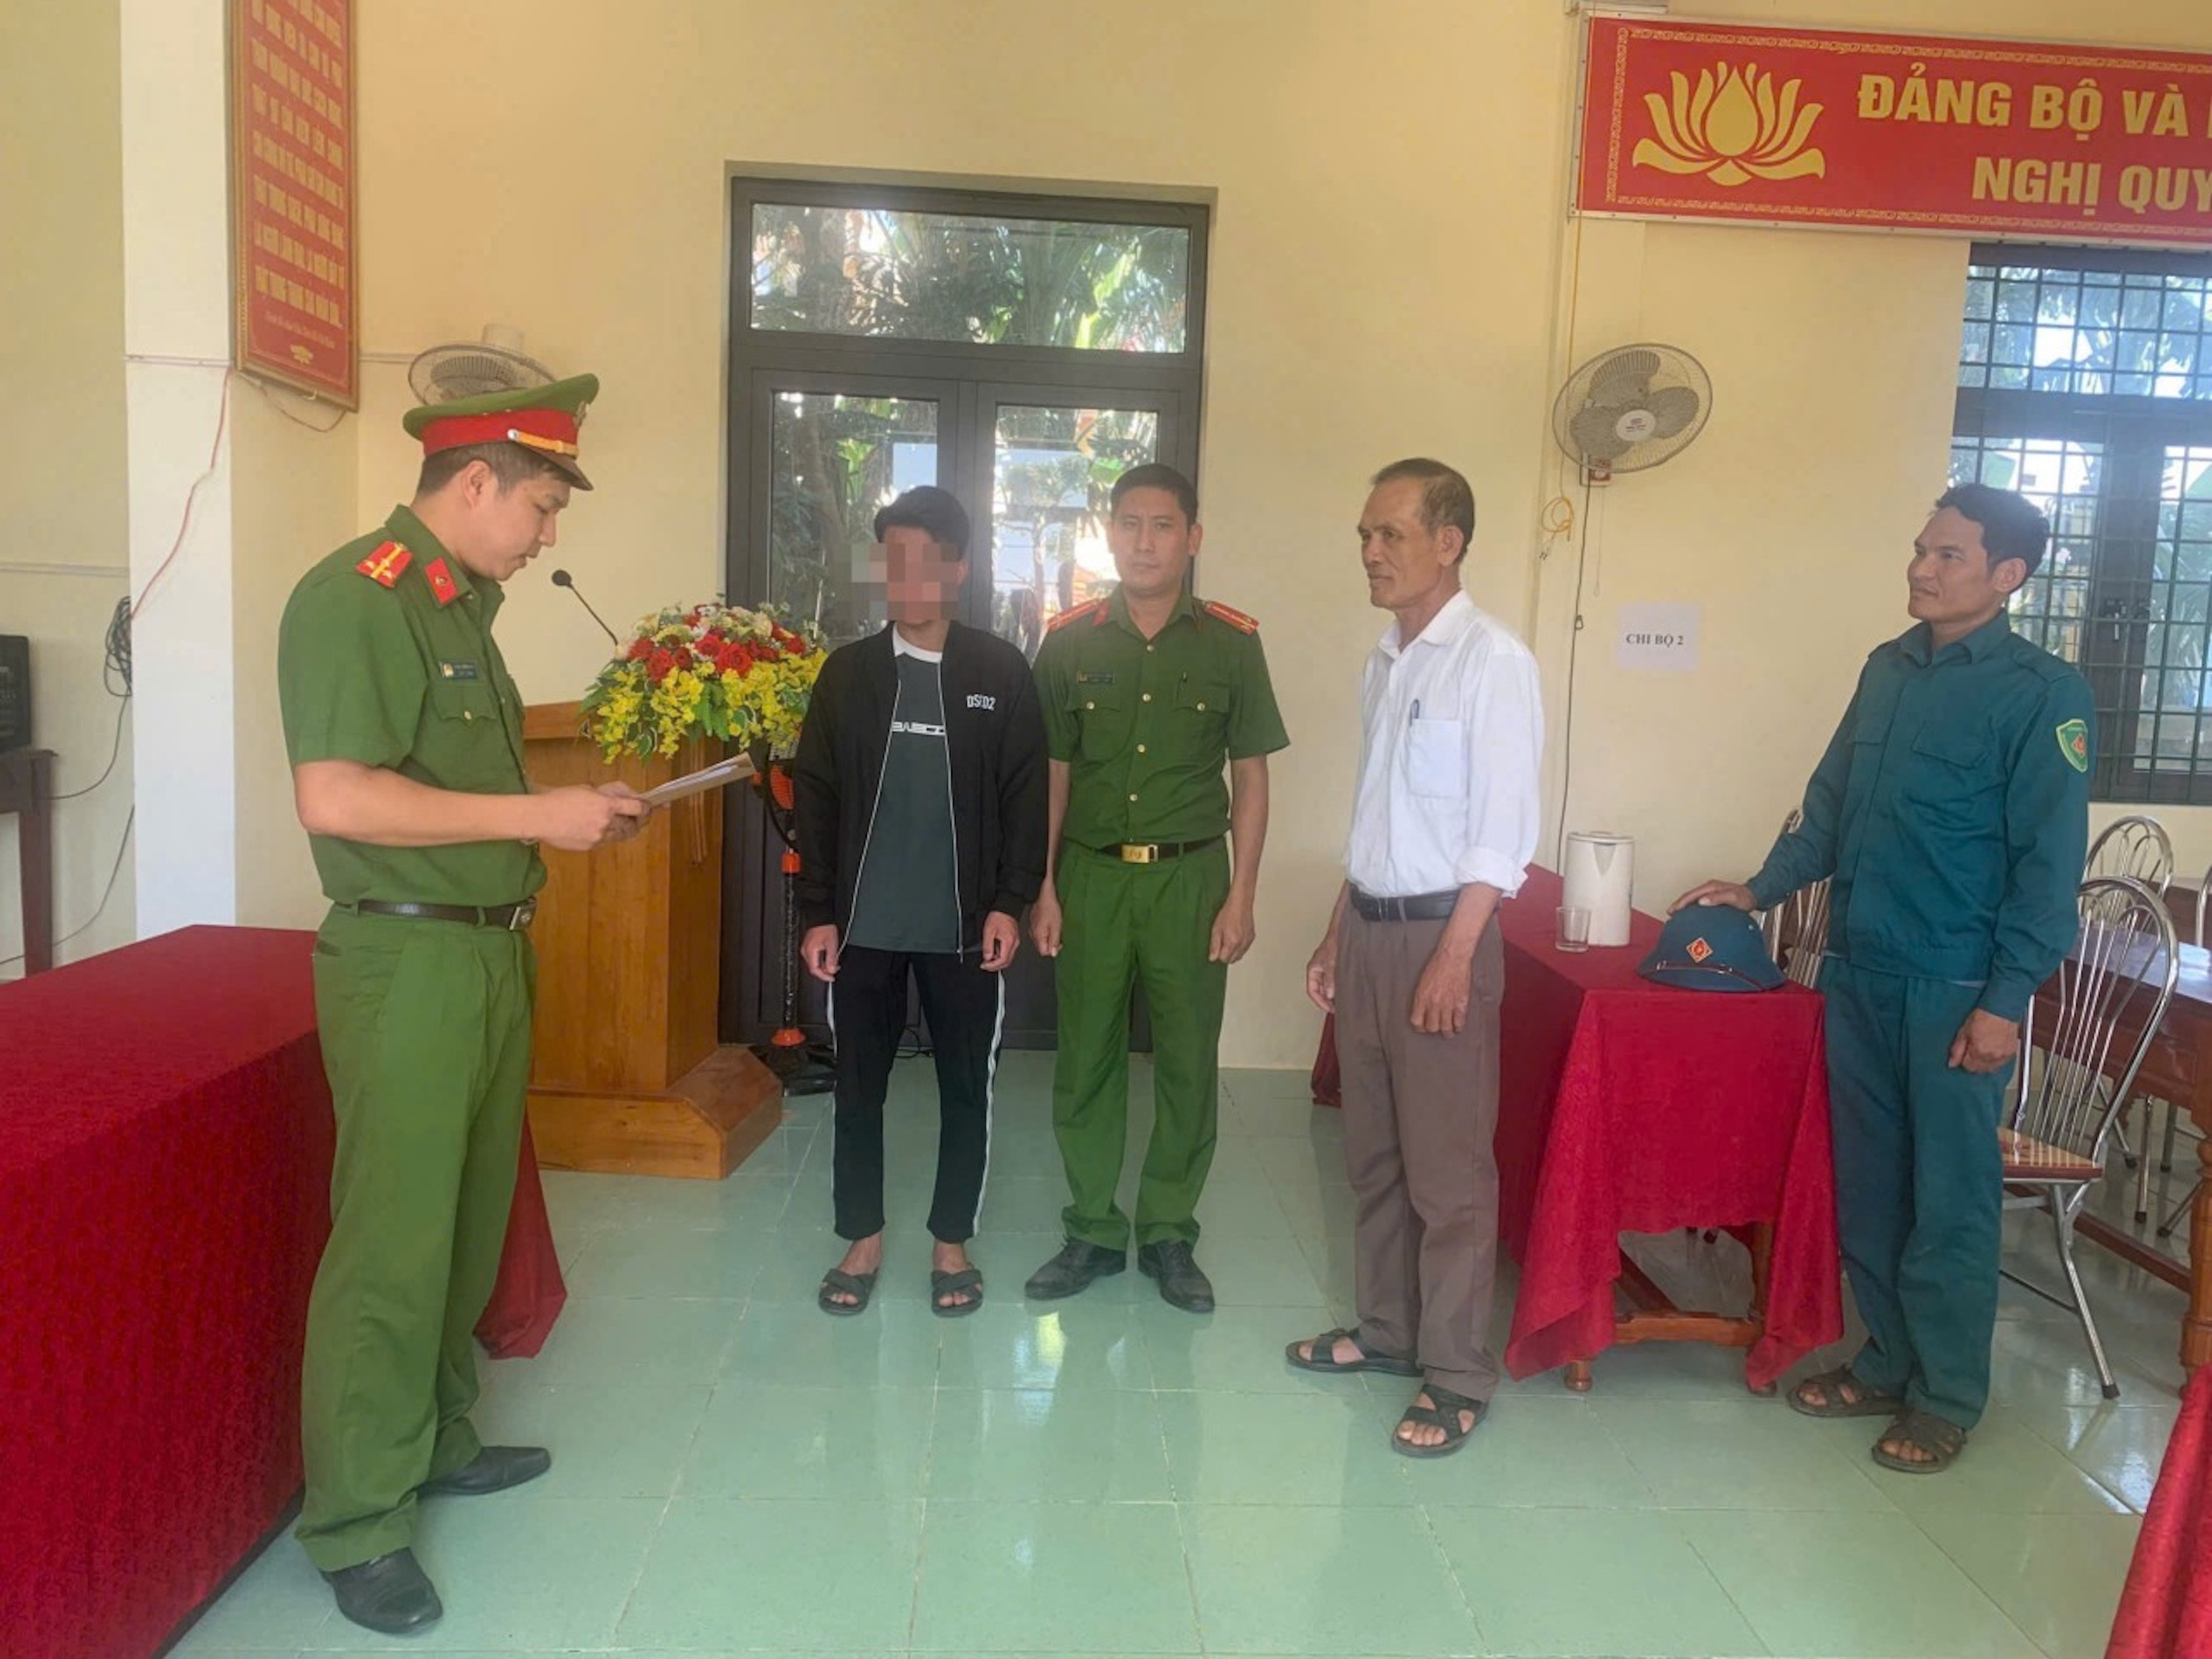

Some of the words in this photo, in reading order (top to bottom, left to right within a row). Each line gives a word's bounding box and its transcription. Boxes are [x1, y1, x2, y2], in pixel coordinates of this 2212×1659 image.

[1857, 62, 2012, 126] ĐẢNG
[2029, 78, 2103, 141] BỘ
[2122, 83, 2189, 137] VÀ
[1972, 156, 2102, 215] NGHỊ
[1625, 634, 1651, 645] CHI
[1677, 635, 1684, 645] 2
